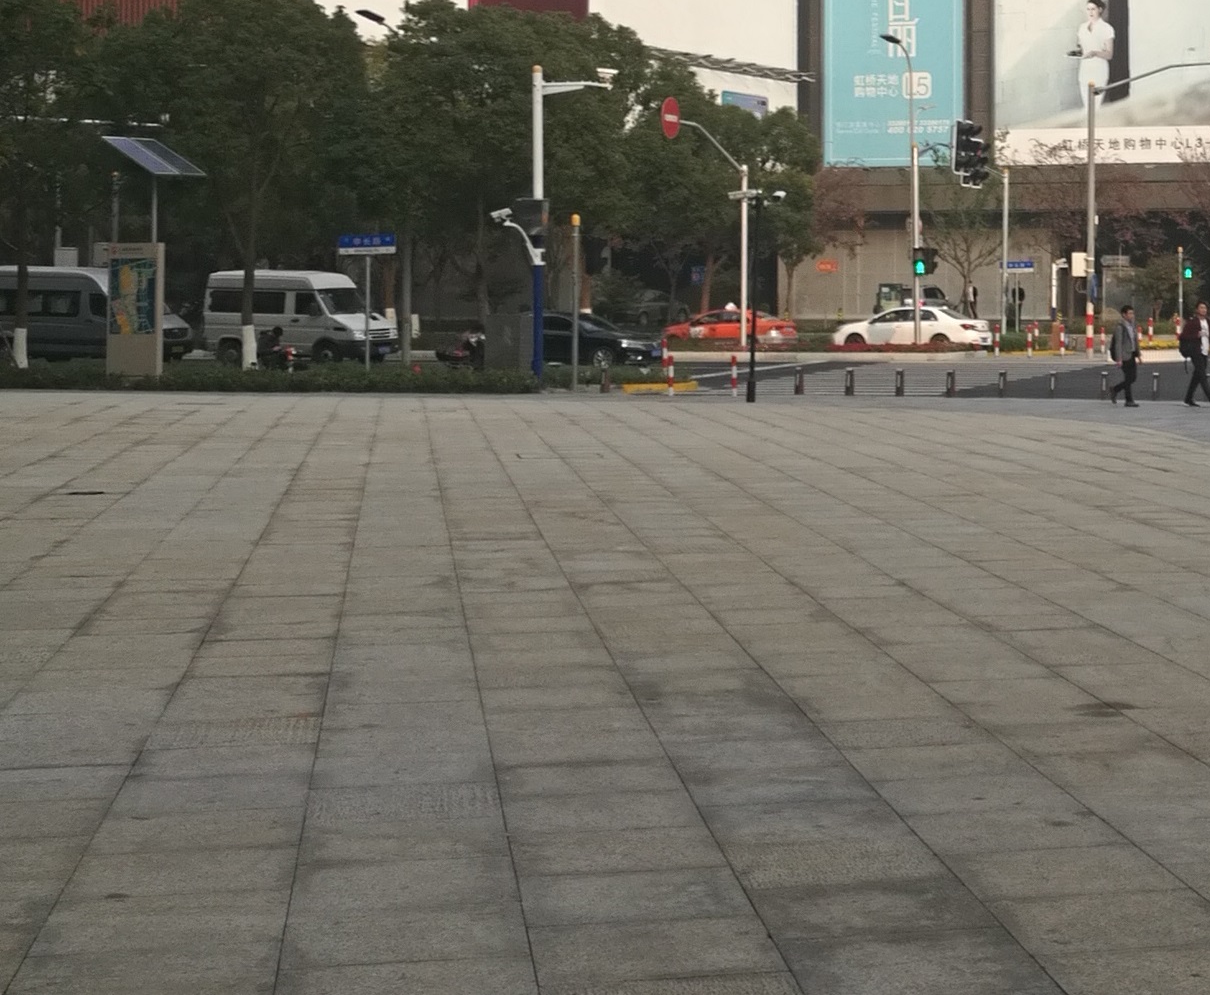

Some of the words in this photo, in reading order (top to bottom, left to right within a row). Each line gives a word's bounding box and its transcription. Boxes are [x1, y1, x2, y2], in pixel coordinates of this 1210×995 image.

[853, 73, 899, 86] 虹桥天地
[904, 75, 930, 97] L5
